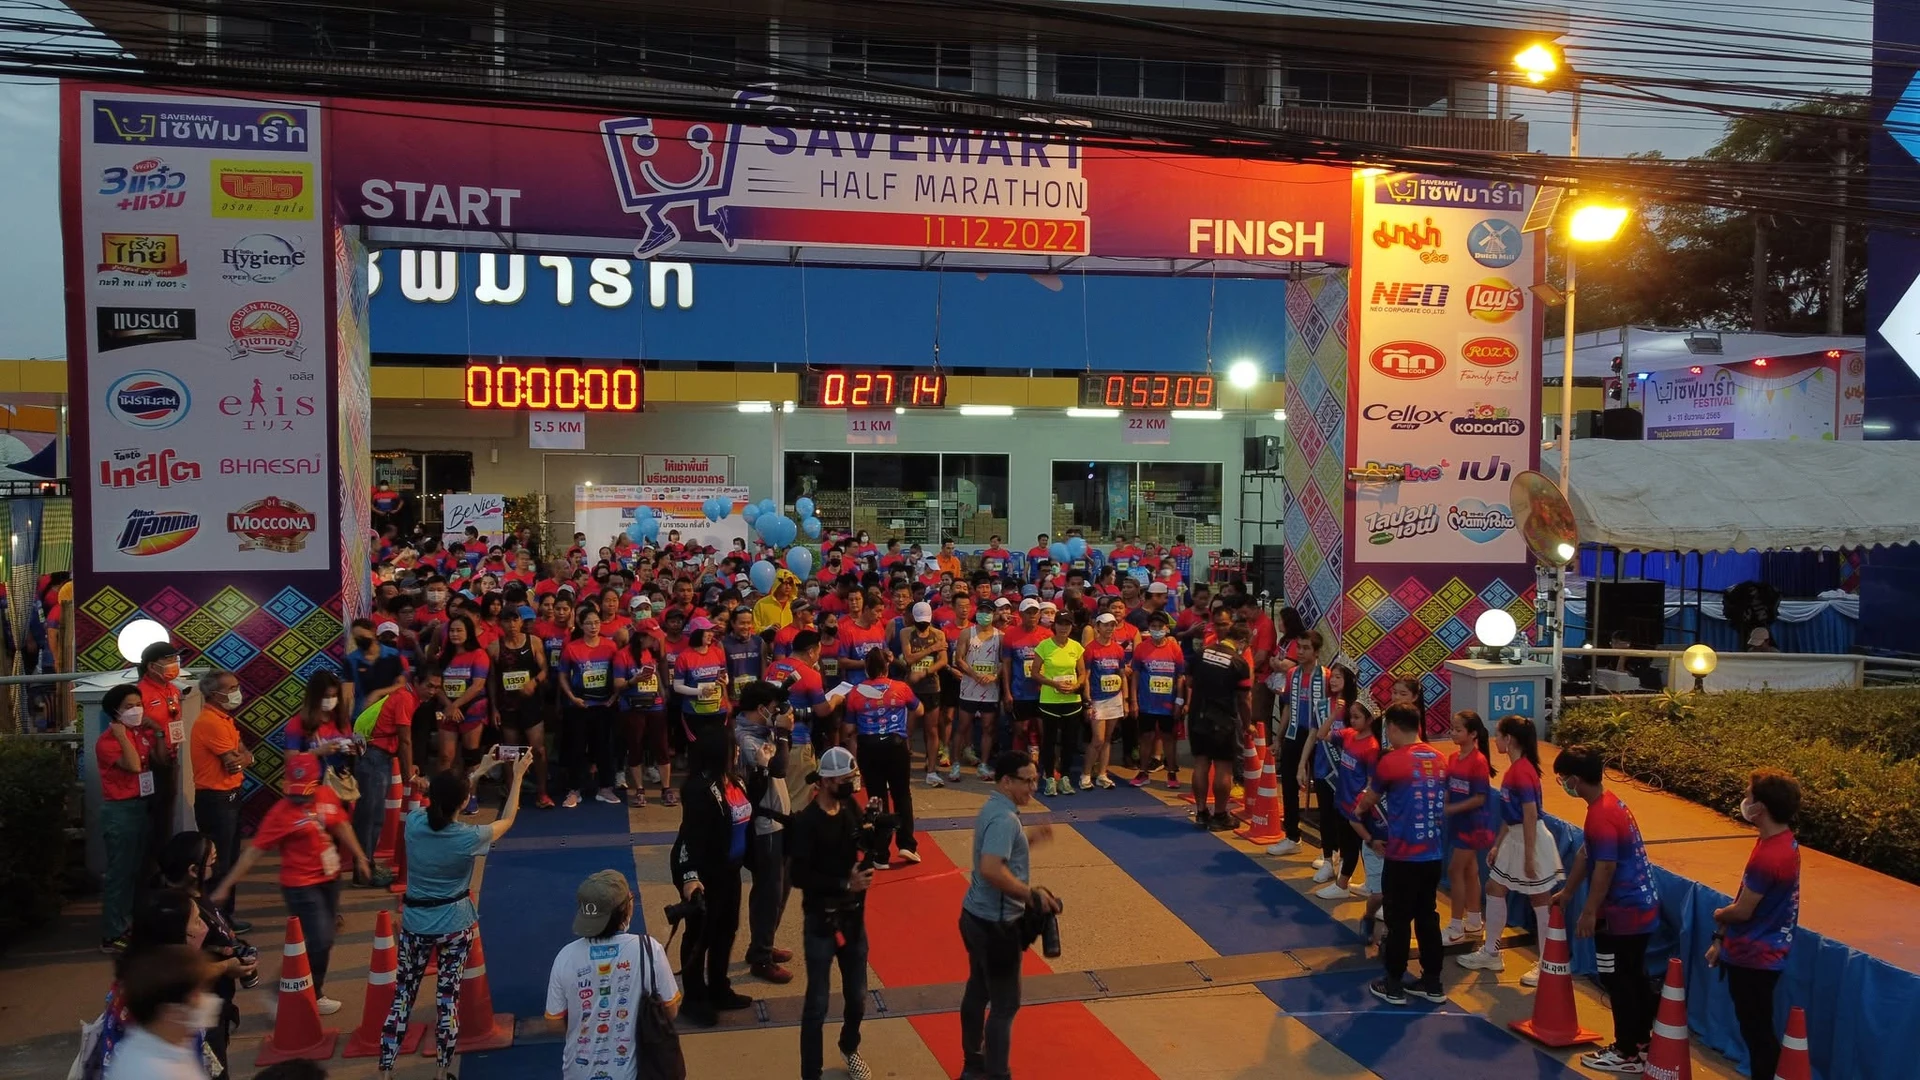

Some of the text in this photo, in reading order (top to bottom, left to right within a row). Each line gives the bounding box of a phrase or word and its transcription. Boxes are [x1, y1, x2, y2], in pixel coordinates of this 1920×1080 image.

[160, 113, 214, 122] SAVEMART
[160, 119, 305, 144] เซฟมาร์ท
[820, 170, 1083, 209] HALF MARATHON
[1420, 184, 1522, 205] เซฟมาร์ท
[361, 179, 521, 227] START
[924, 216, 1077, 250] 11.12.2022
[1189, 218, 1324, 256] FINISH
[221, 248, 305, 269] Hygiene
[1475, 252, 1497, 260] Dutch
[1370, 282, 1450, 307] NEO
[231, 302, 298, 334] GOLDEN MOUNTAIN
[1466, 345, 1513, 359] ROZA
[1460, 369, 1519, 385] Family Food
[467, 365, 637, 410] 00:00:00
[1694, 397, 1735, 408] FESTIVAL
[1362, 403, 1449, 425] Cellox
[243, 420, 294, 431] エリス
[533, 420, 581, 433] 5.5 KM
[852, 420, 891, 431] 11 KM
[1128, 419, 1165, 430] 22 KM
[220, 458, 320, 474] BHAESAJ
[664, 458, 709, 472] ให้เช่าพื้นที่
[1458, 455, 1512, 482] เปา
[126, 508, 156, 519] Attack
[1447, 507, 1515, 530] MamyPoko
[233, 515, 311, 530] MOCCONA
[506, 676, 526, 685] 1359
[587, 675, 605, 683] 1345
[1104, 679, 1119, 687] 1274
[444, 684, 461, 692] 1967
[1493, 687, 1529, 713] เข้า
